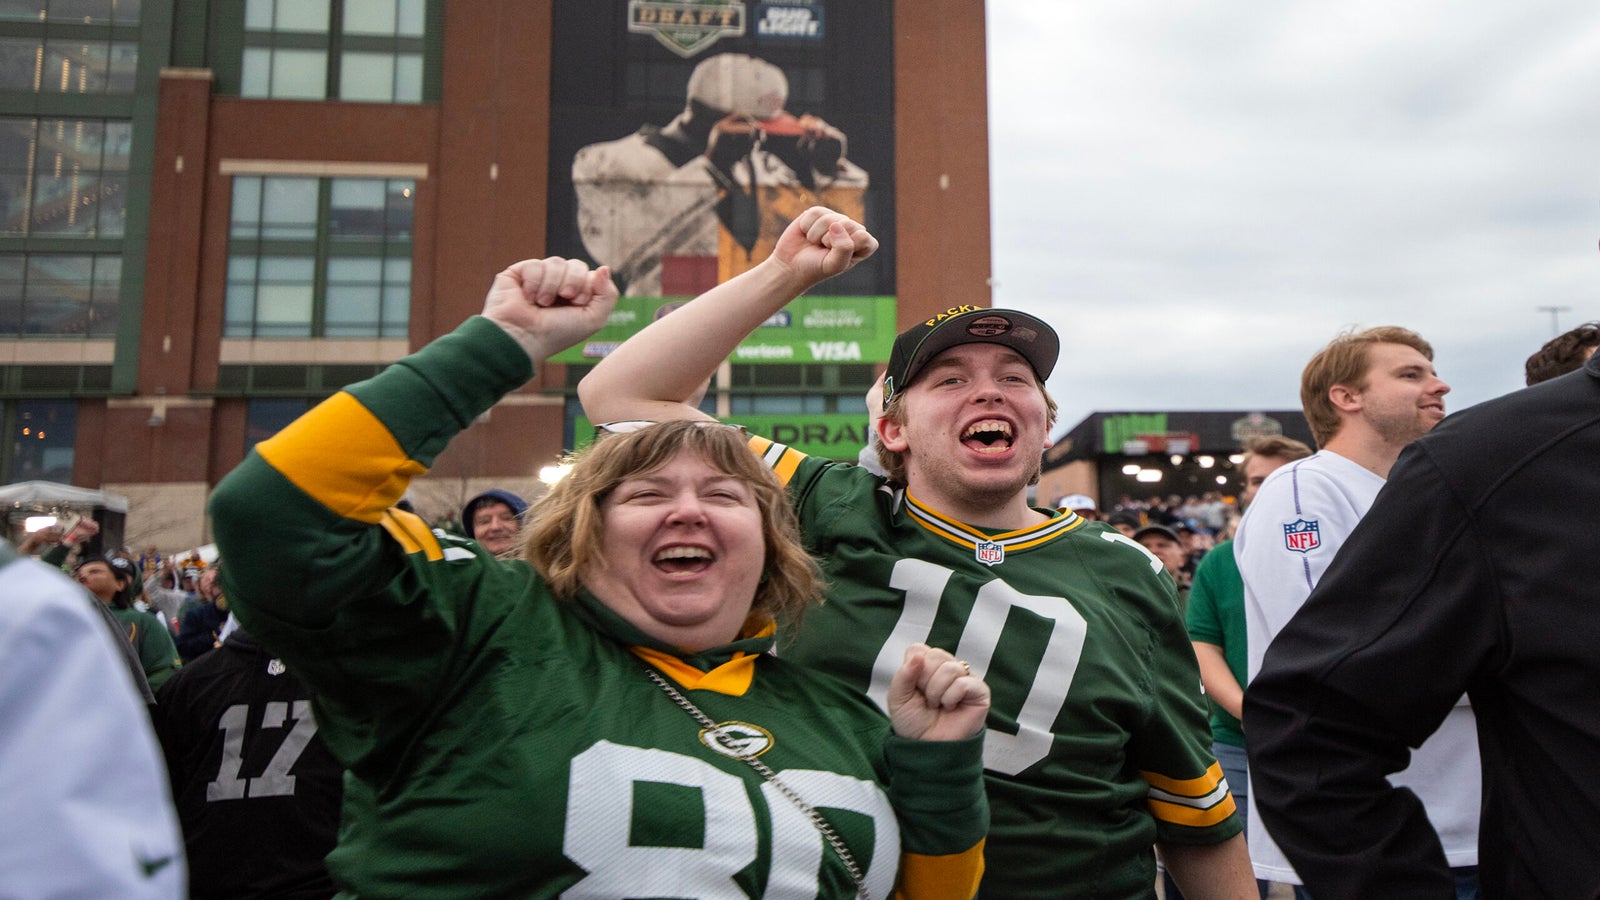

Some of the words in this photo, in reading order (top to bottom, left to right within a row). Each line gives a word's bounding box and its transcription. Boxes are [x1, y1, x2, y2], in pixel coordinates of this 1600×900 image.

[639, 7, 736, 26] DRAFT
[766, 7, 812, 20] BUD
[758, 18, 820, 36] LIGHT
[736, 344, 794, 359] verizon
[808, 341, 861, 361] VISA
[1288, 532, 1318, 549] NFL
[981, 549, 1000, 561] NFL
[866, 558, 1088, 777] 10
[206, 699, 320, 803] 17
